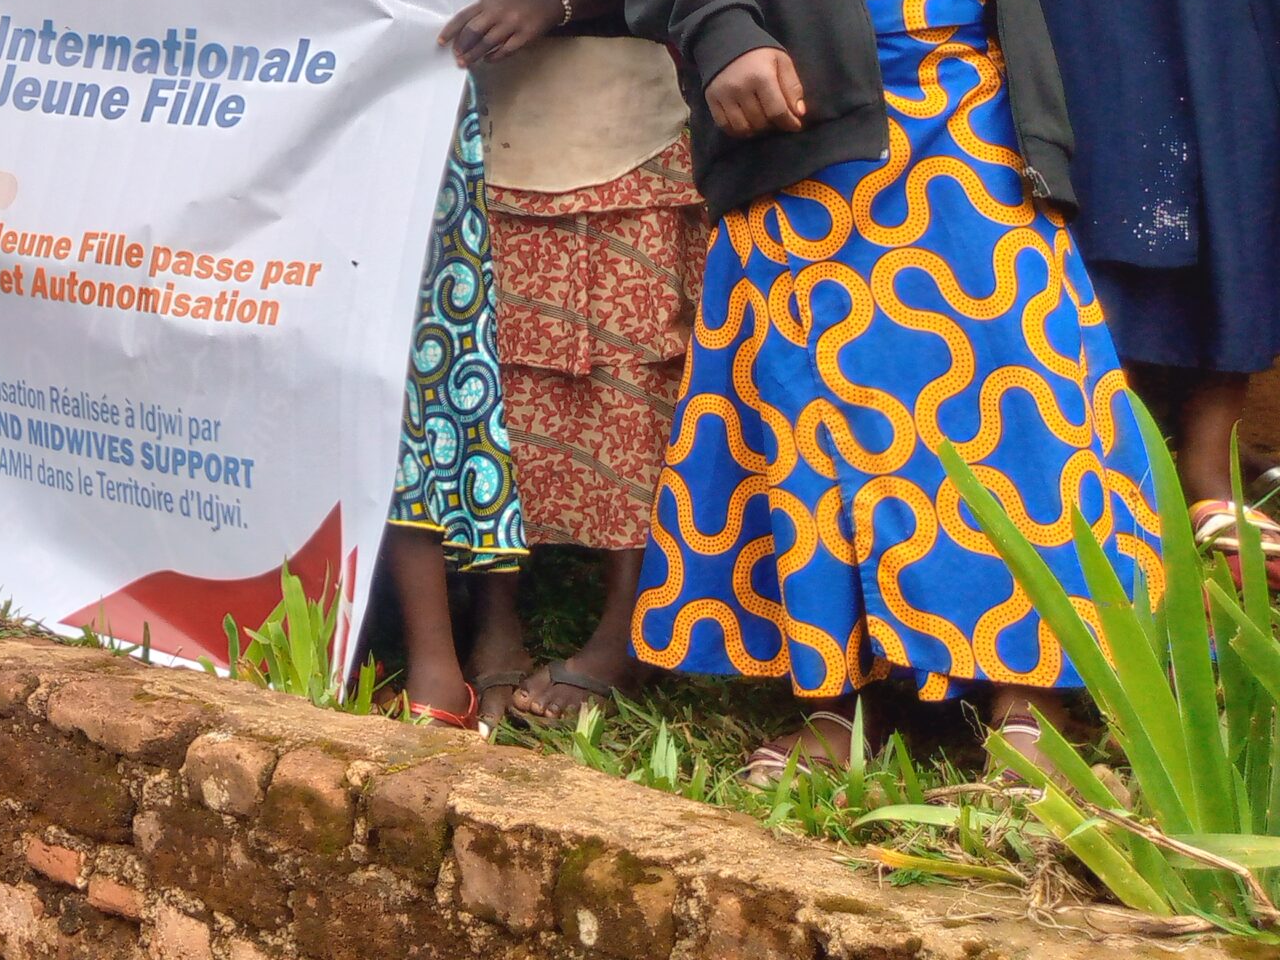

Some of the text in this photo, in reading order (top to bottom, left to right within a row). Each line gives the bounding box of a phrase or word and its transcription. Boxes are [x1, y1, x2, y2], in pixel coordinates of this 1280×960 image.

[140, 78, 246, 128] Fille
[78, 232, 144, 268] Fille
[149, 243, 254, 282] passe
[260, 258, 322, 290] par
[30, 266, 280, 326] Autonomisation
[49, 385, 120, 427] Réalisée
[124, 397, 135, 428] à
[139, 401, 183, 441] Idjwi
[187, 415, 222, 446] par
[28, 418, 135, 466] MIDWIVES
[140, 441, 254, 488] SUPPORT
[37, 458, 75, 493] dans
[78, 467, 93, 497] le
[96, 470, 174, 515] Territoire
[179, 489, 248, 531] d'Idjwi.
